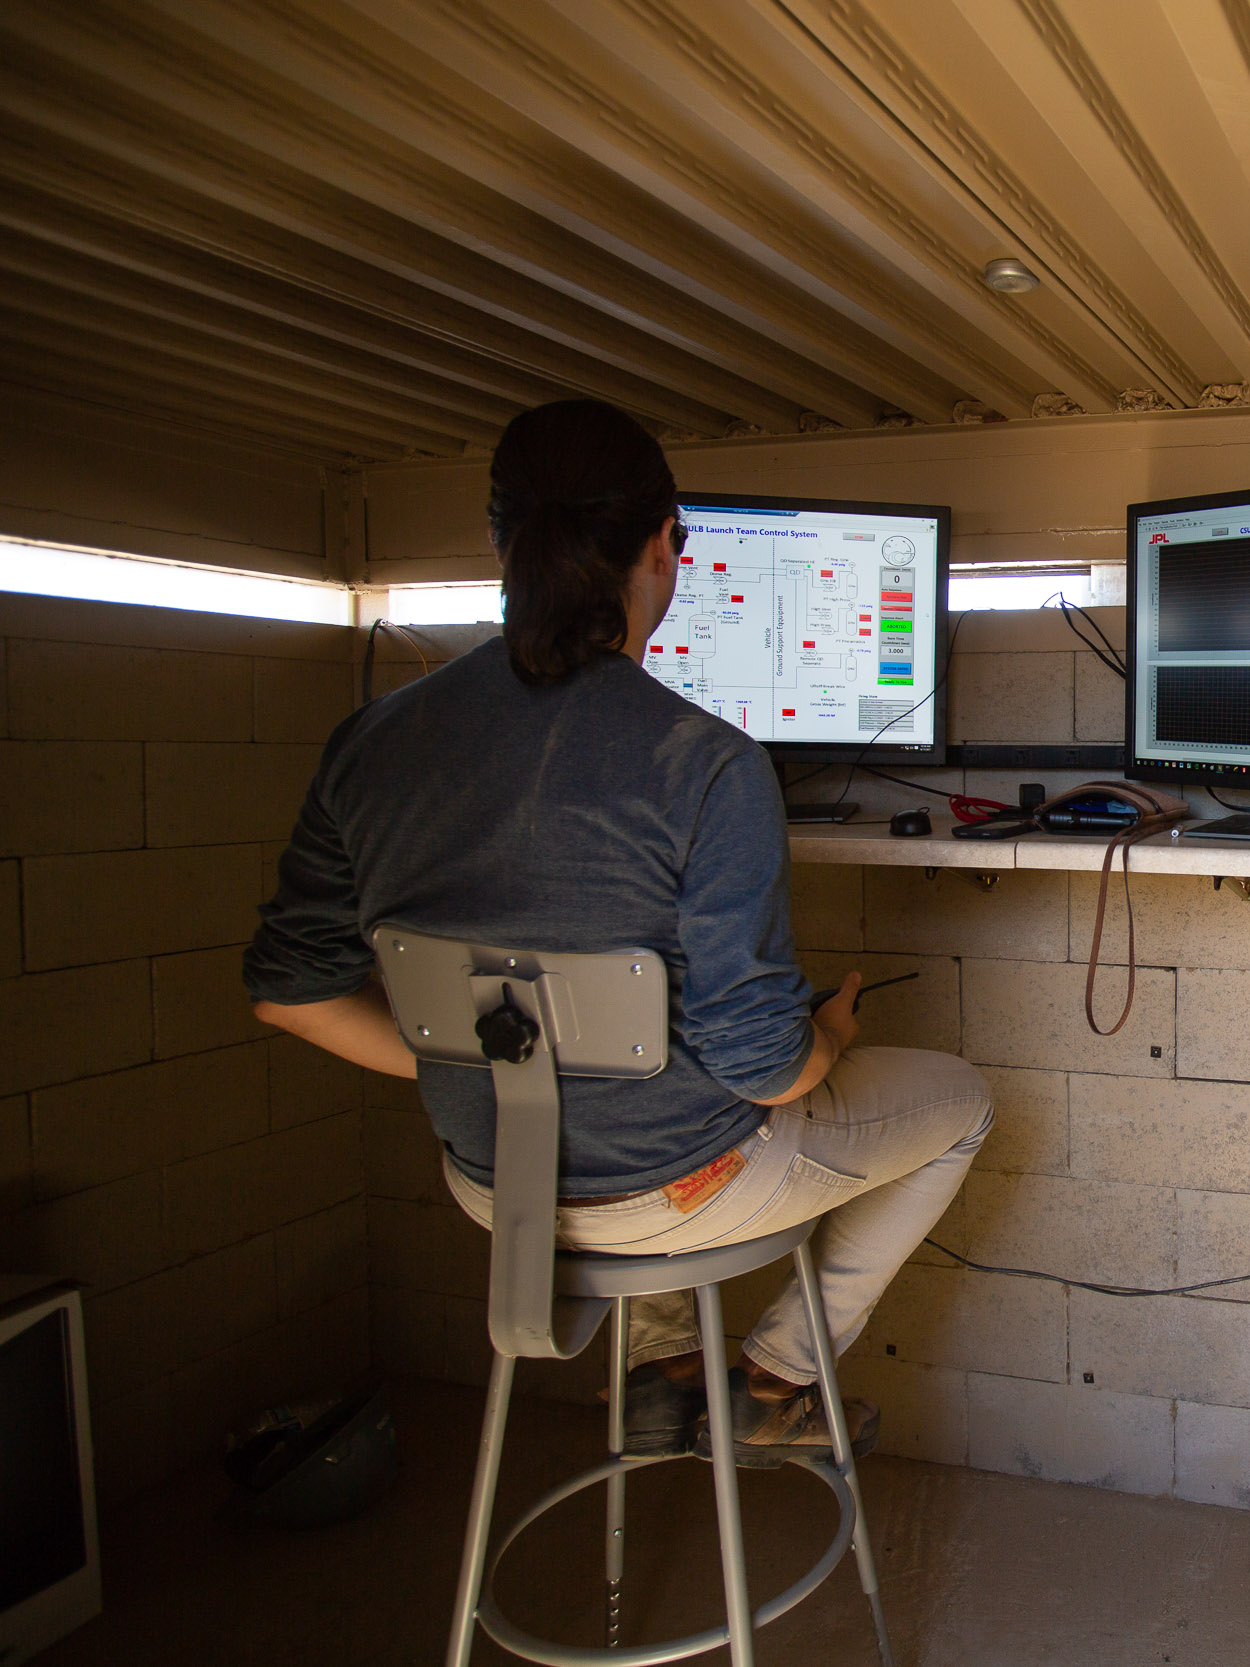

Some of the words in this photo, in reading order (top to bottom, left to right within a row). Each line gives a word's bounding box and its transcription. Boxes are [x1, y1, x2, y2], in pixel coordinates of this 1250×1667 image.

[687, 525, 704, 533] ULB
[706, 526, 734, 534] Launch
[736, 527, 758, 536] Team
[759, 528, 789, 537] Control
[790, 530, 818, 539] System
[1149, 533, 1170, 545] JPL
[894, 575, 900, 583] 0
[776, 595, 784, 630] Equipment
[764, 627, 772, 649] Vehicle
[776, 632, 784, 654] Support
[776, 655, 784, 676] Ground
